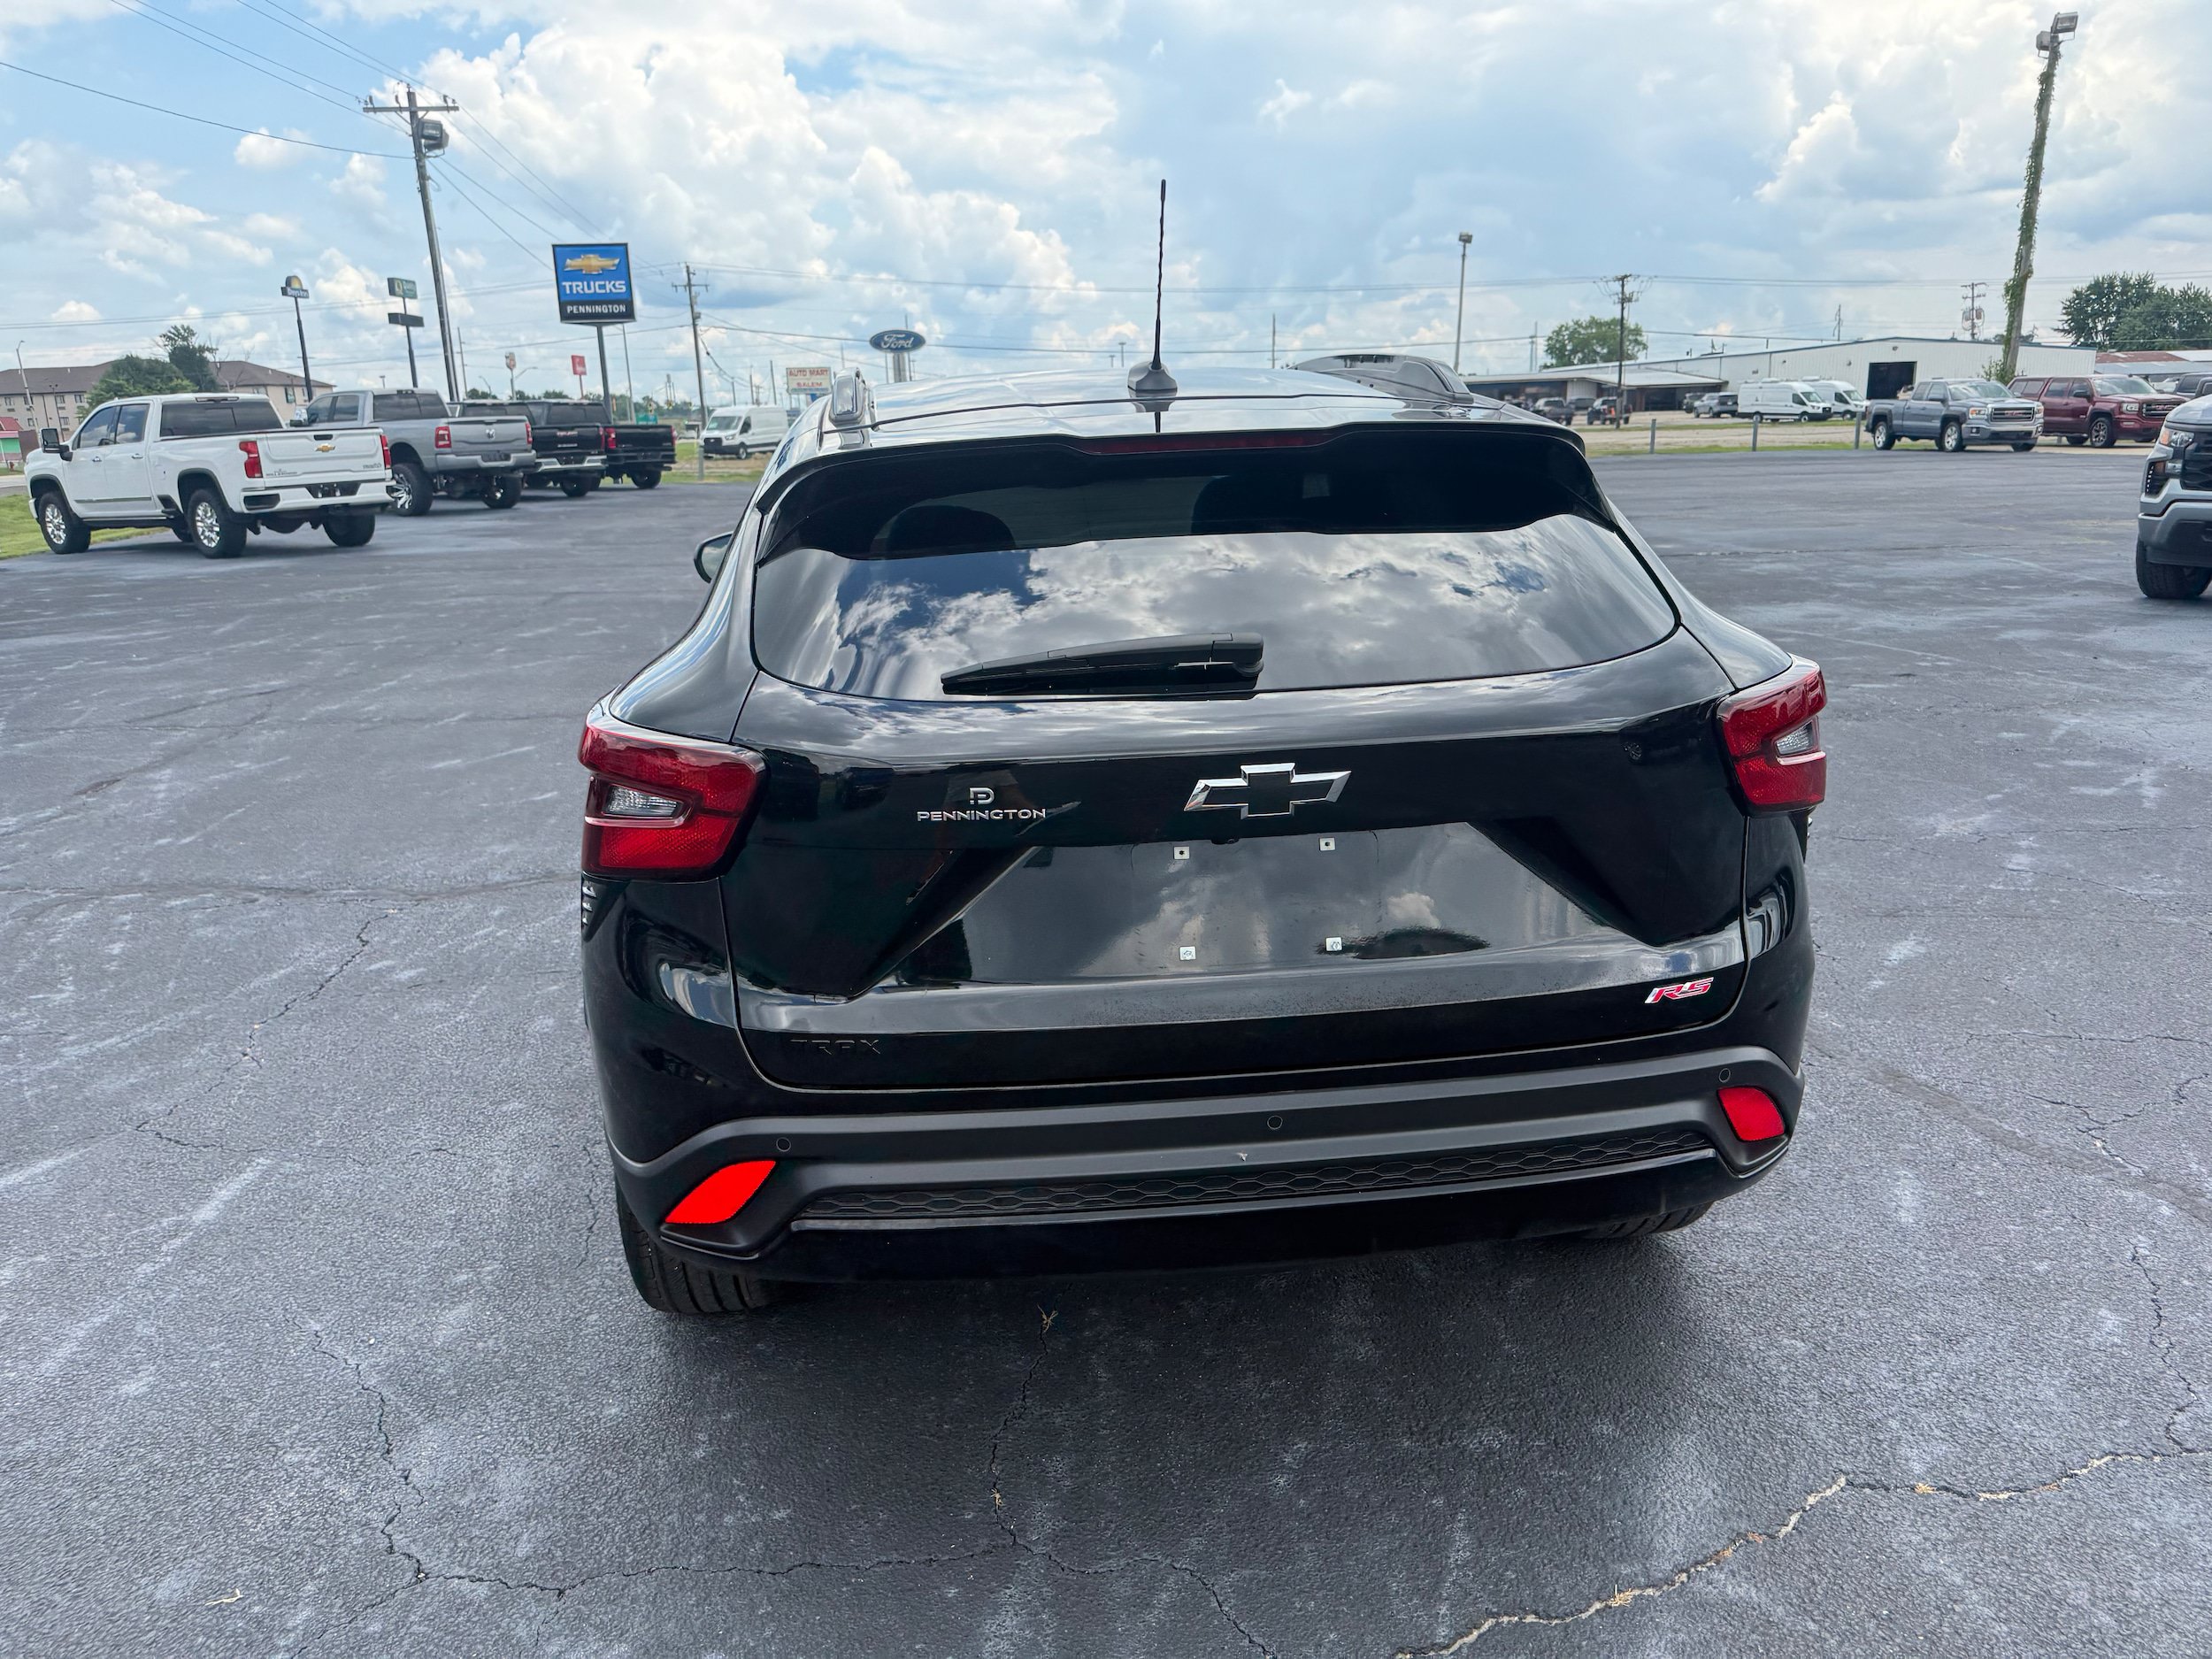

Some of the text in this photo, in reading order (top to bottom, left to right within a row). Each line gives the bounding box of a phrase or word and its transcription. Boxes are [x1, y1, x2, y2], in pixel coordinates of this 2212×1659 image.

[562, 280, 626, 294] TRUCKS
[567, 304, 626, 314] PENNINGTON
[880, 334, 913, 349] Ford
[917, 808, 1047, 822] PENNINGTON
[1644, 976, 1715, 1004] RS
